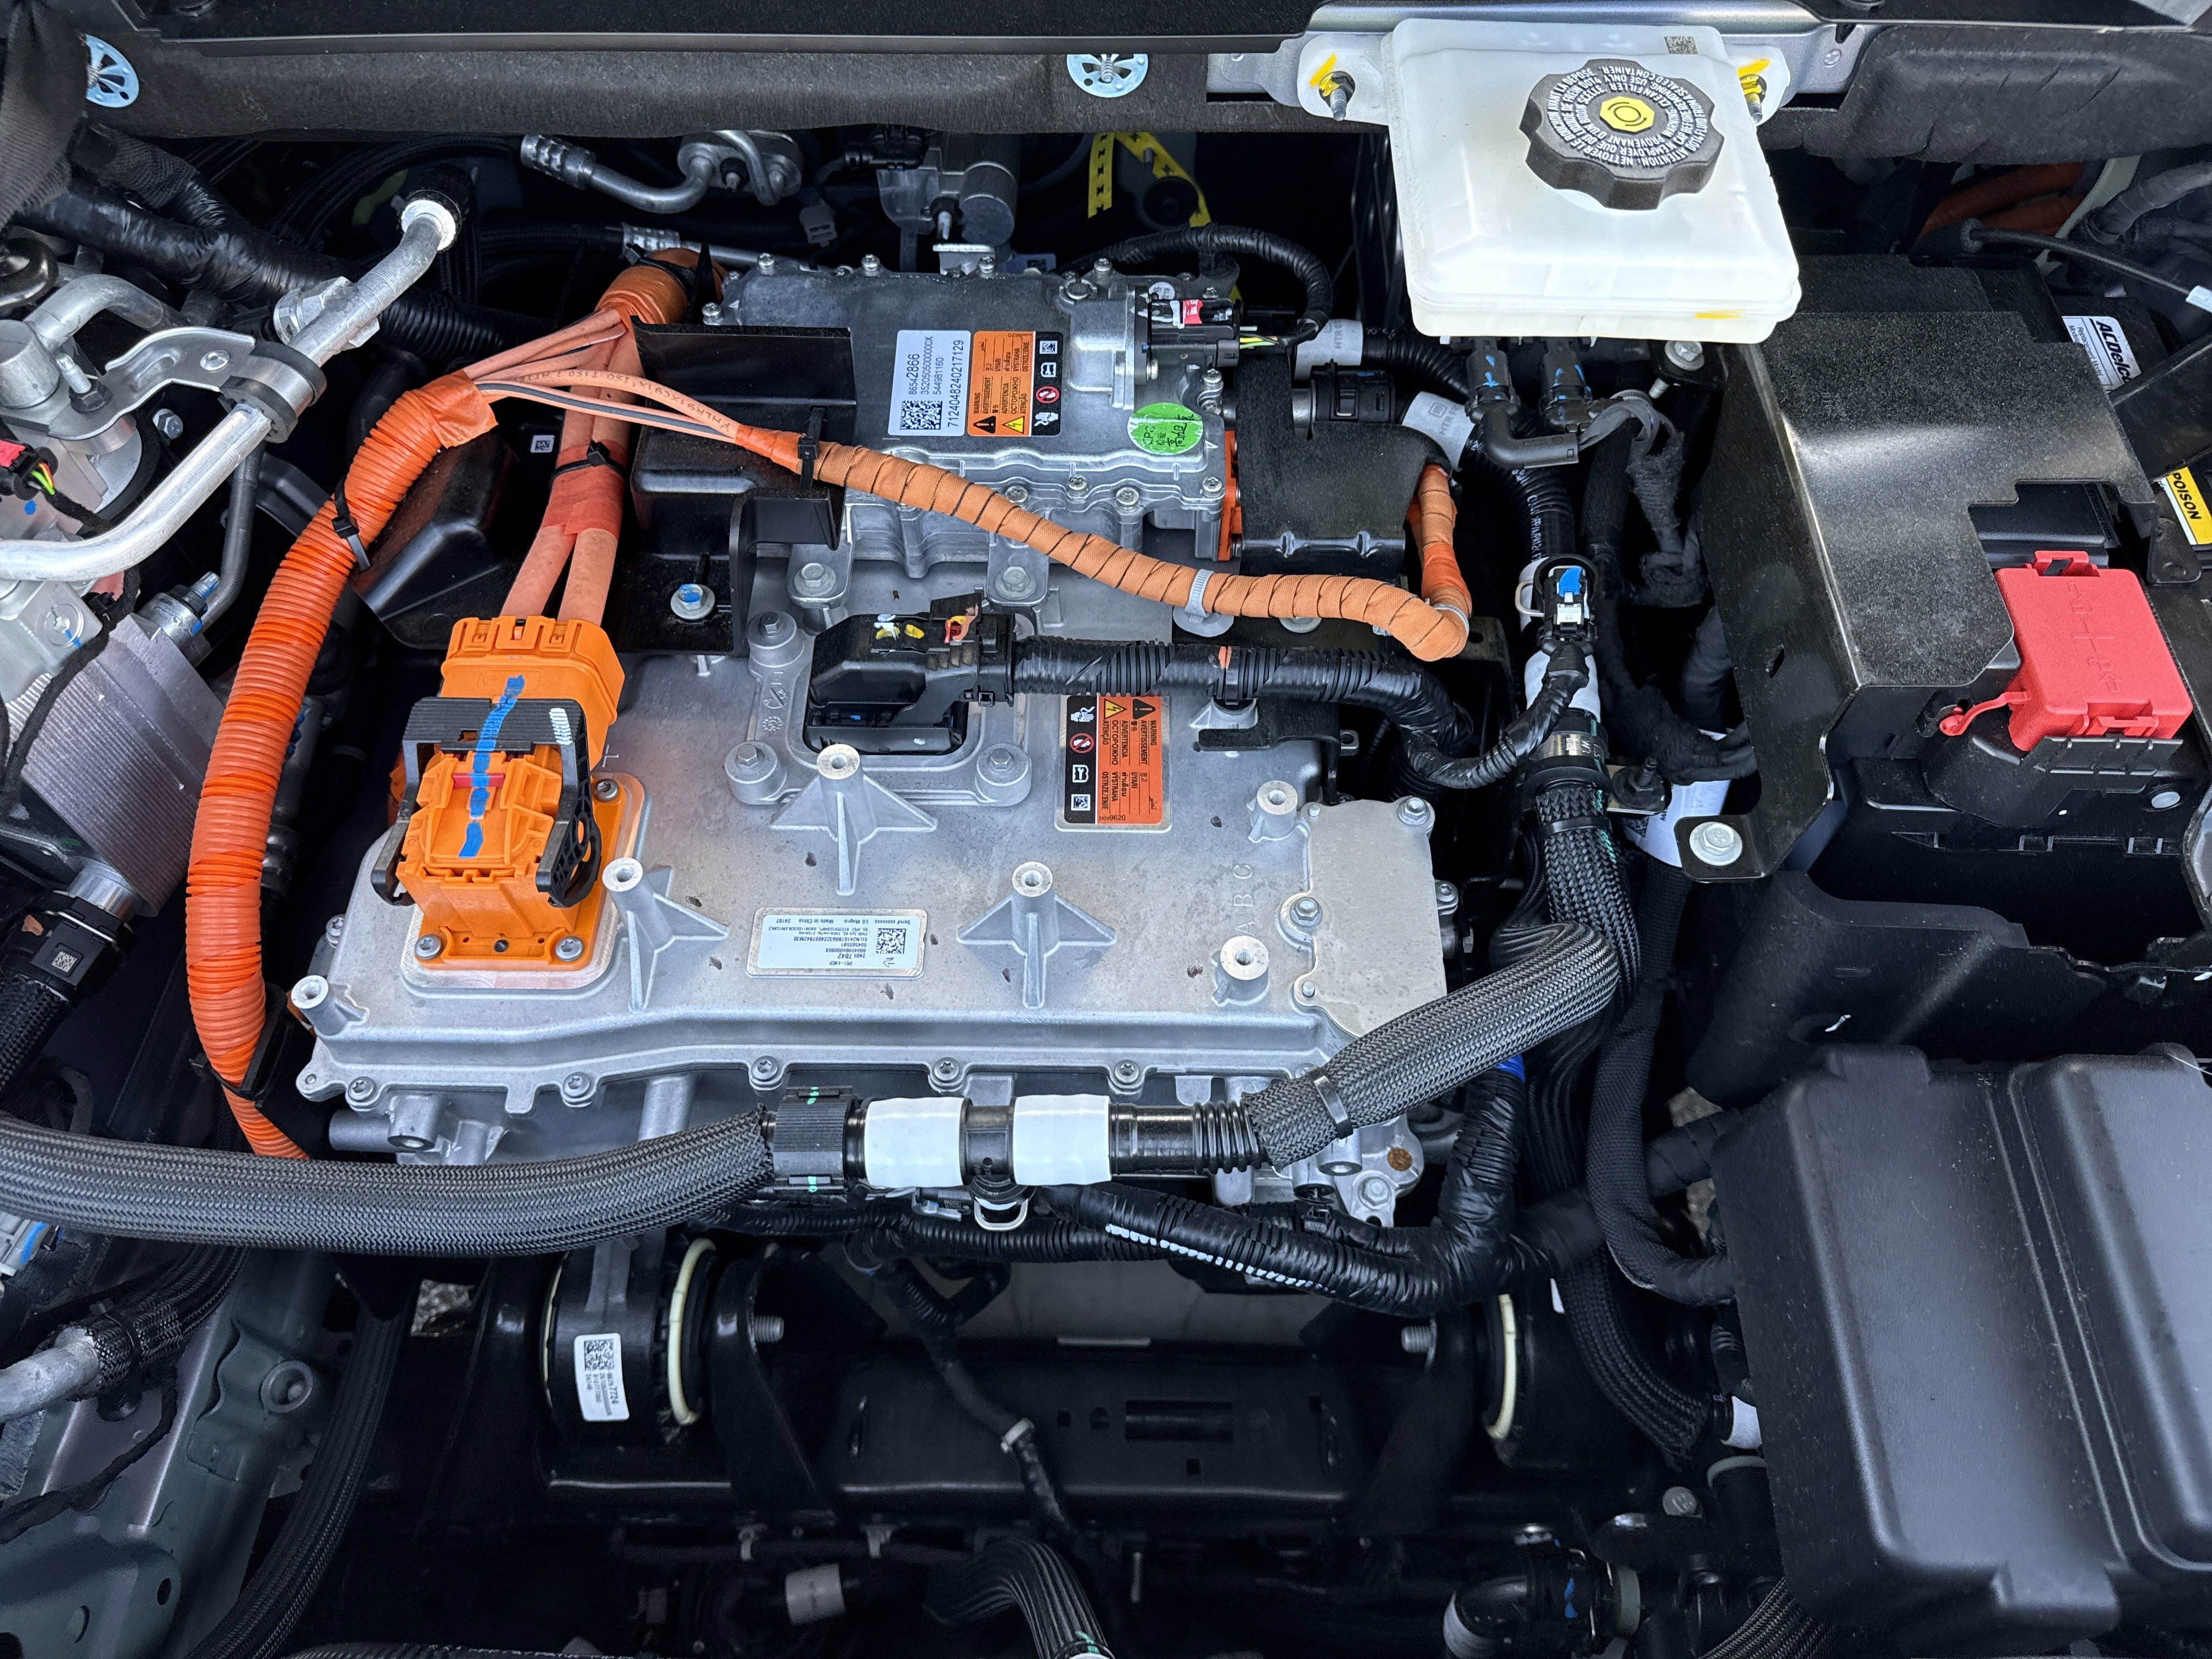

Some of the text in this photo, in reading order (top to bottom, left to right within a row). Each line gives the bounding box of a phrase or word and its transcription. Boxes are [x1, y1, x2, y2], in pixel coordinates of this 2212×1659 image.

[1562, 68, 1598, 85] DEPOSE.
[1578, 76, 1602, 89] DOT4
[1599, 66, 1656, 80] CONTAINER.
[1630, 76, 1647, 86] USE
[1554, 82, 1568, 92] LA
[1562, 85, 1583, 103] FREIN
[1610, 82, 1643, 94] FILLER
[1656, 76, 1688, 96] SEALED
[1547, 91, 1562, 110] AVANT
[1561, 103, 1573, 111] DE
[1643, 88, 1671, 108] CLEAN
[1575, 84, 1665, 148] PROVENANT D'UN BIDON SCELLE.
[1689, 100, 1706, 117] FROM
[1548, 112, 1576, 142] BOUCHON
[1561, 112, 1586, 136] LIQUIDE
[1680, 110, 1694, 134] BEFORE
[1694, 117, 1707, 137] FLUID
[1571, 138, 1585, 150] LE
[1581, 134, 1598, 145] DU
[1597, 140, 1617, 153] QUE
[1673, 132, 1689, 145] CAP
[1685, 135, 1705, 151] DOT4
[1584, 145, 1633, 165] NETTOYER
[906, 354, 919, 395] 86542866
[933, 357, 944, 395] 544981160
[947, 340, 963, 427] 7124048240217129
[983, 377, 991, 414] AVERTISSEMENT
[2173, 472, 2202, 519] POISON
[1102, 720, 1110, 745] ATENÇÃO
